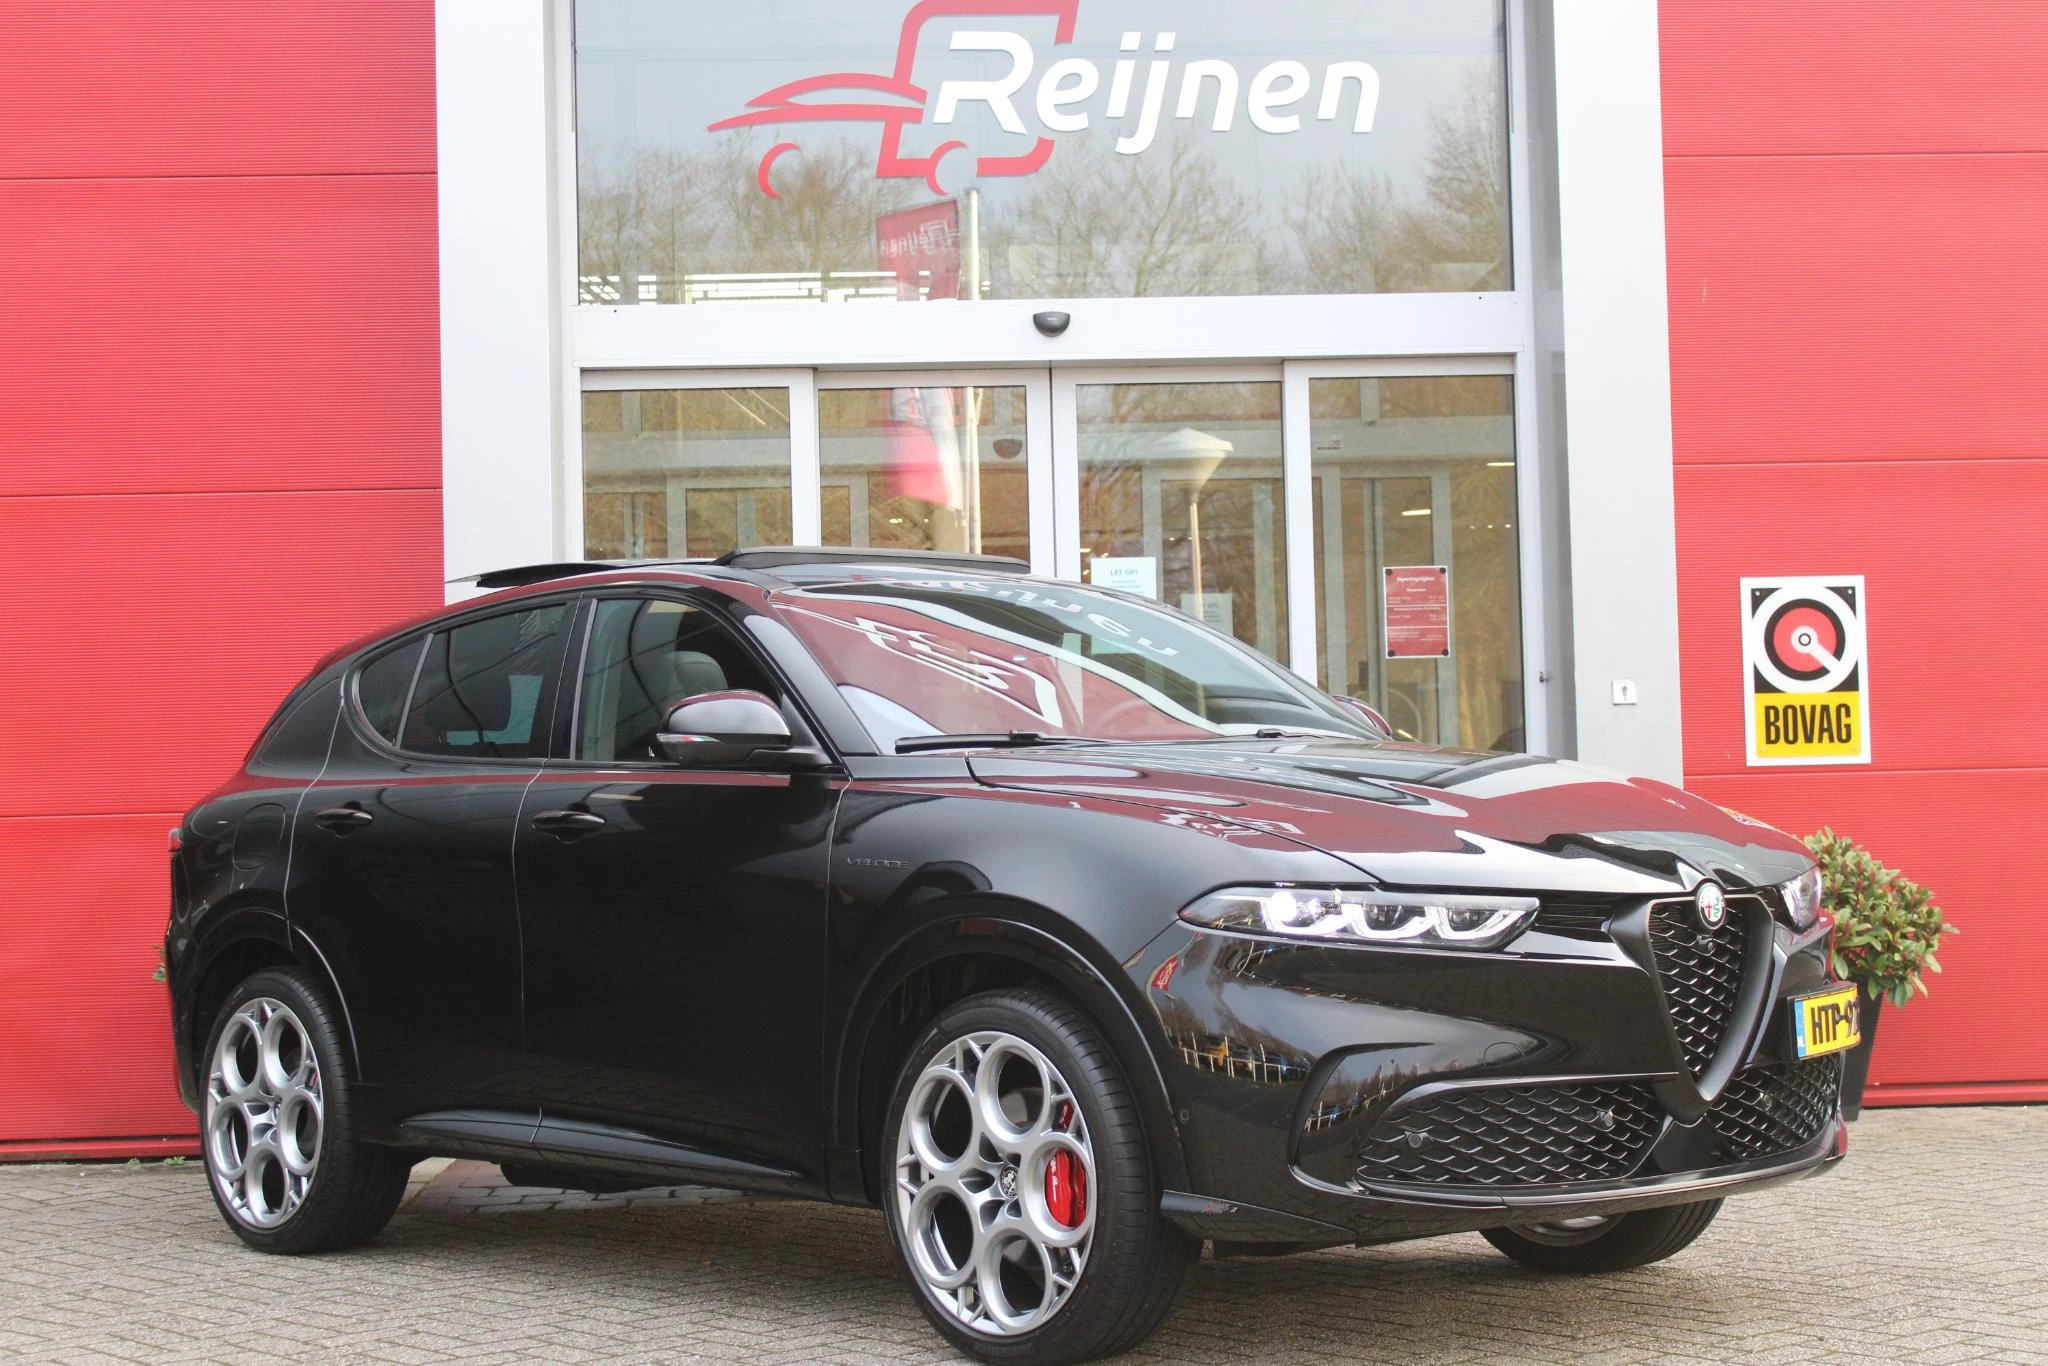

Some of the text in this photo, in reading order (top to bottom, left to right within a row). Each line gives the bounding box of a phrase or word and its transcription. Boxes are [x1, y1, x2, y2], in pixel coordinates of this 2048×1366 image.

[932, 31, 1380, 155] Reijnen
[1110, 568, 1138, 576] LET OP!
[1764, 703, 1852, 745] BOVAG
